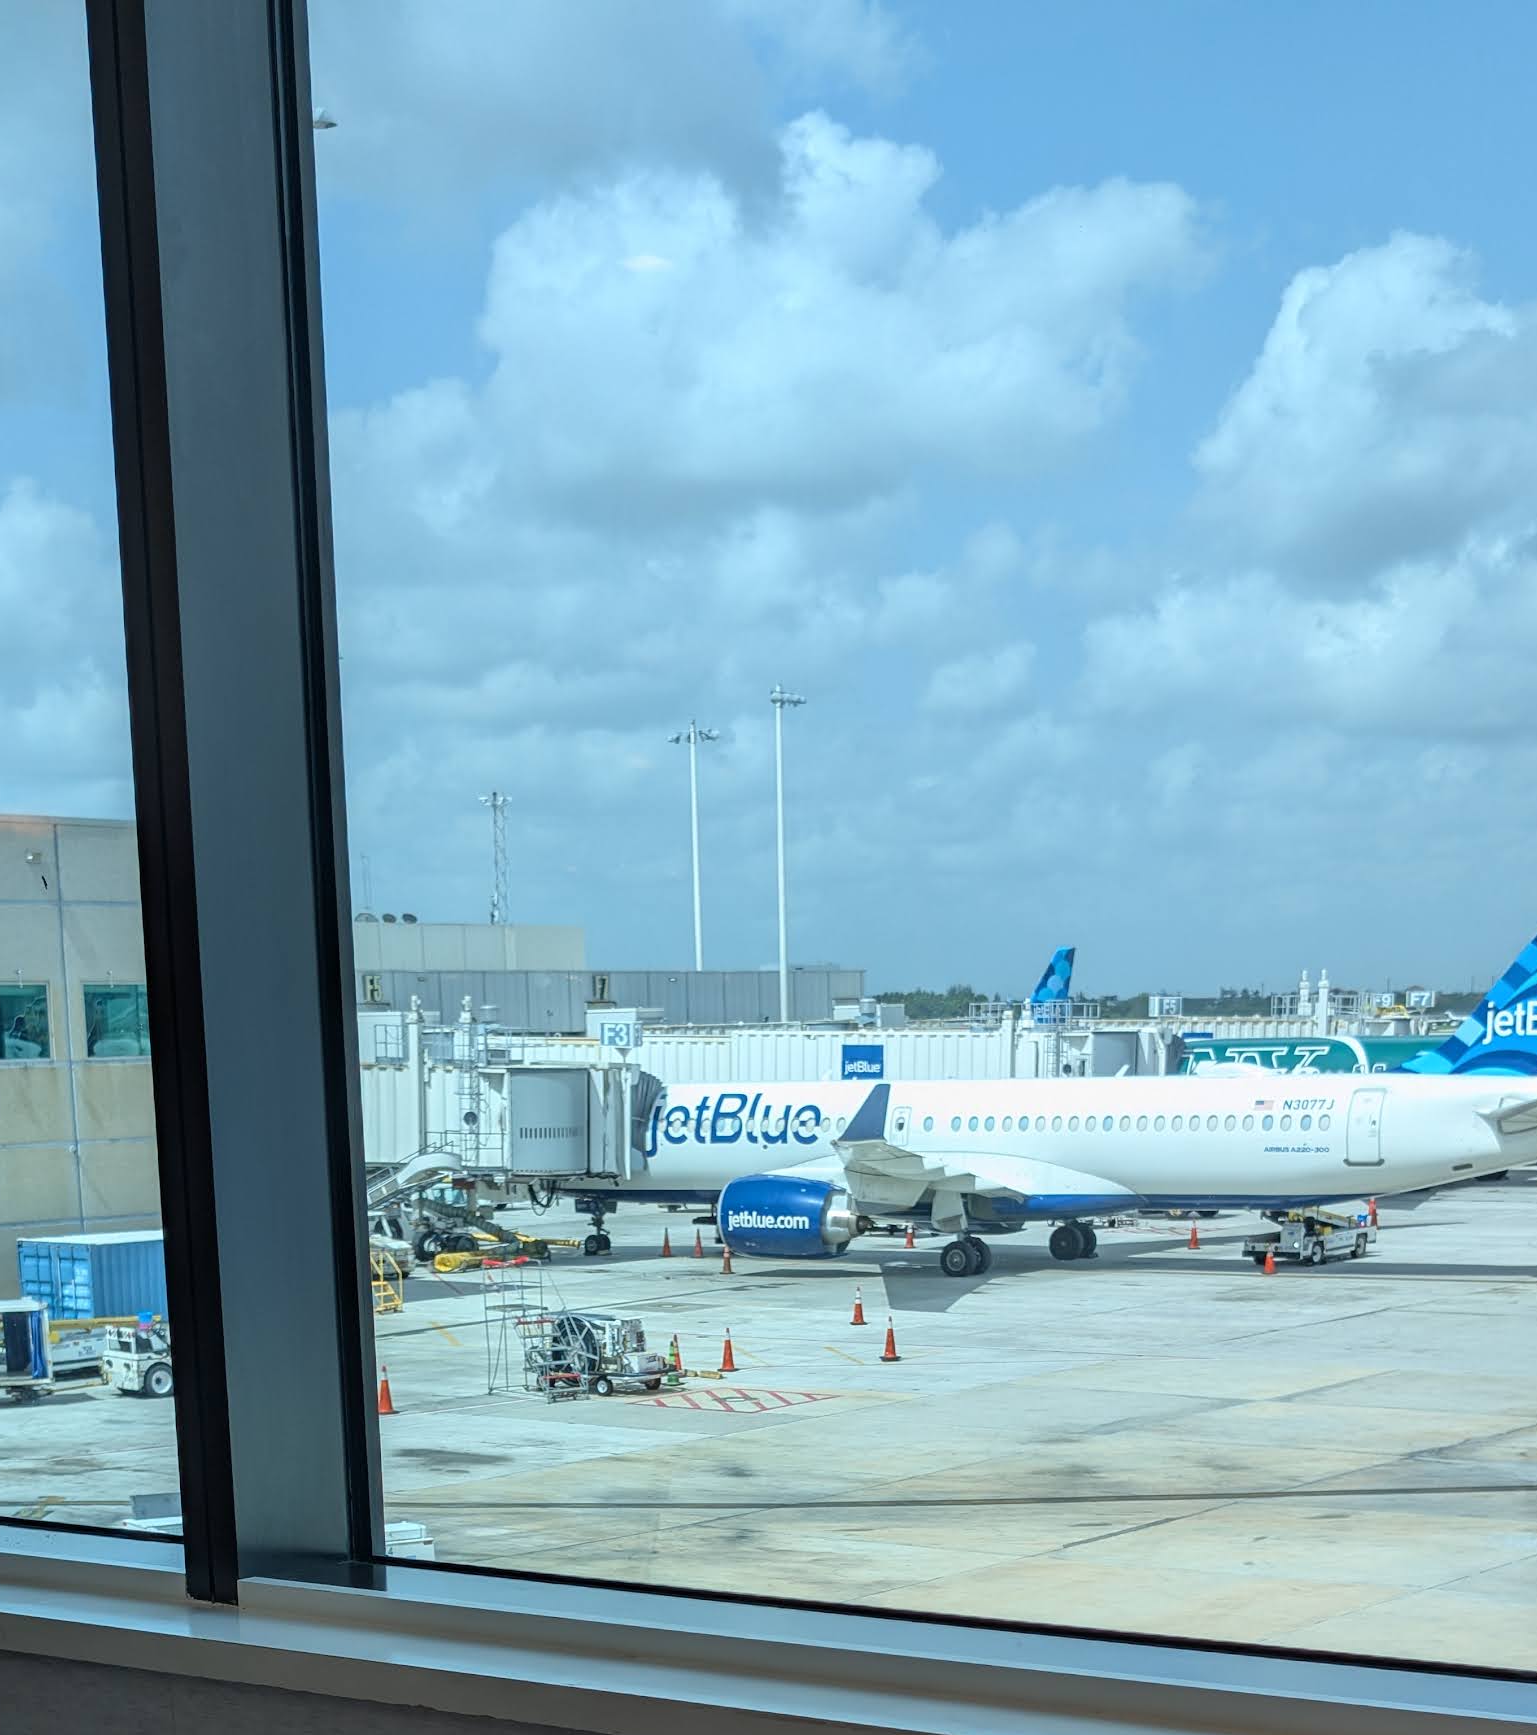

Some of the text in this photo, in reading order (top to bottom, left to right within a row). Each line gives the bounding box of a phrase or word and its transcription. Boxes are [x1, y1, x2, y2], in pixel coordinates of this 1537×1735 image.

[603, 1024, 629, 1046] F3
[844, 1060, 881, 1075] jetBlue
[1283, 1099, 1335, 1111] N3077J
[645, 1087, 822, 1158] jetBlue
[727, 1210, 810, 1232] jetblue.com
